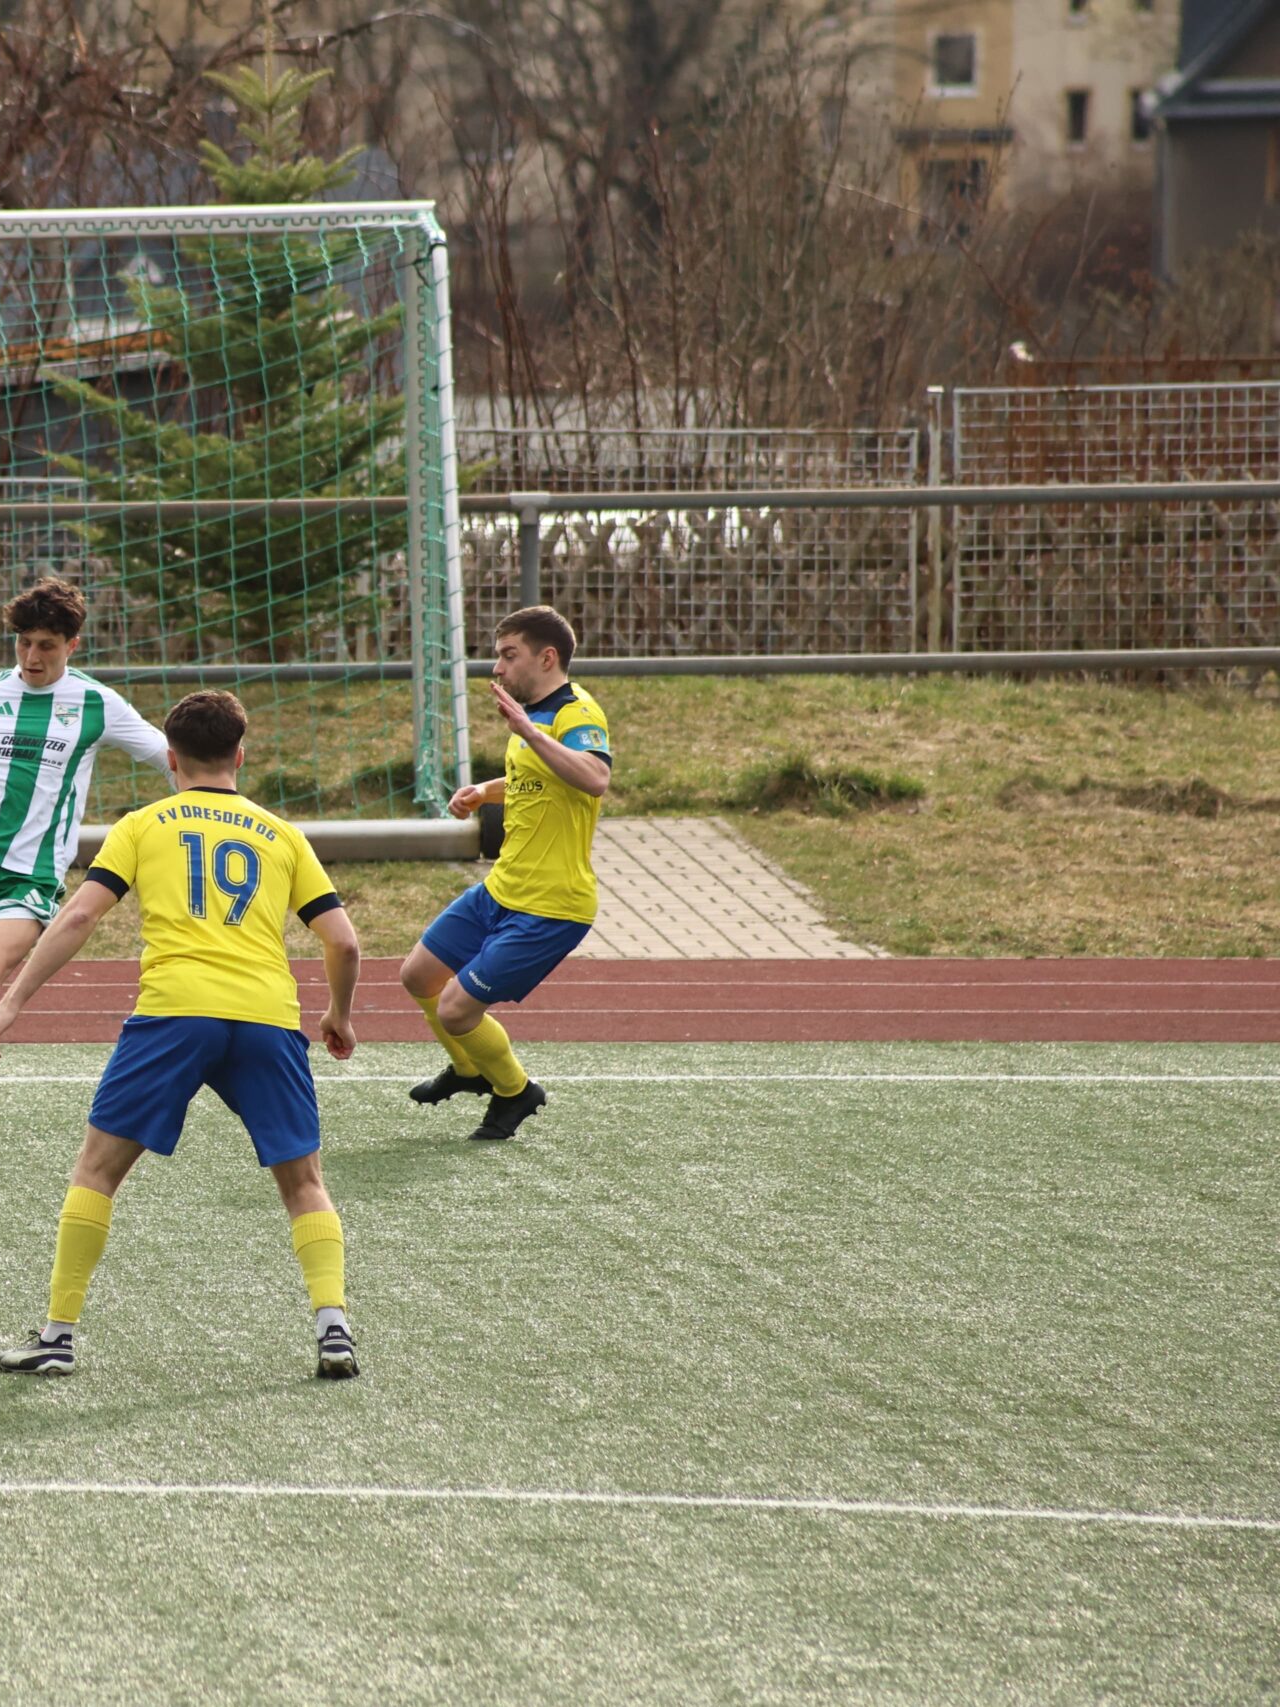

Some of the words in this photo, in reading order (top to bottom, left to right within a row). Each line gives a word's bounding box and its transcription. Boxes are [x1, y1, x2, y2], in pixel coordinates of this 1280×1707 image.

[157, 808, 177, 824] FV
[180, 805, 254, 829] DRESDEN
[255, 823, 277, 842] 06
[179, 831, 261, 926] 19
